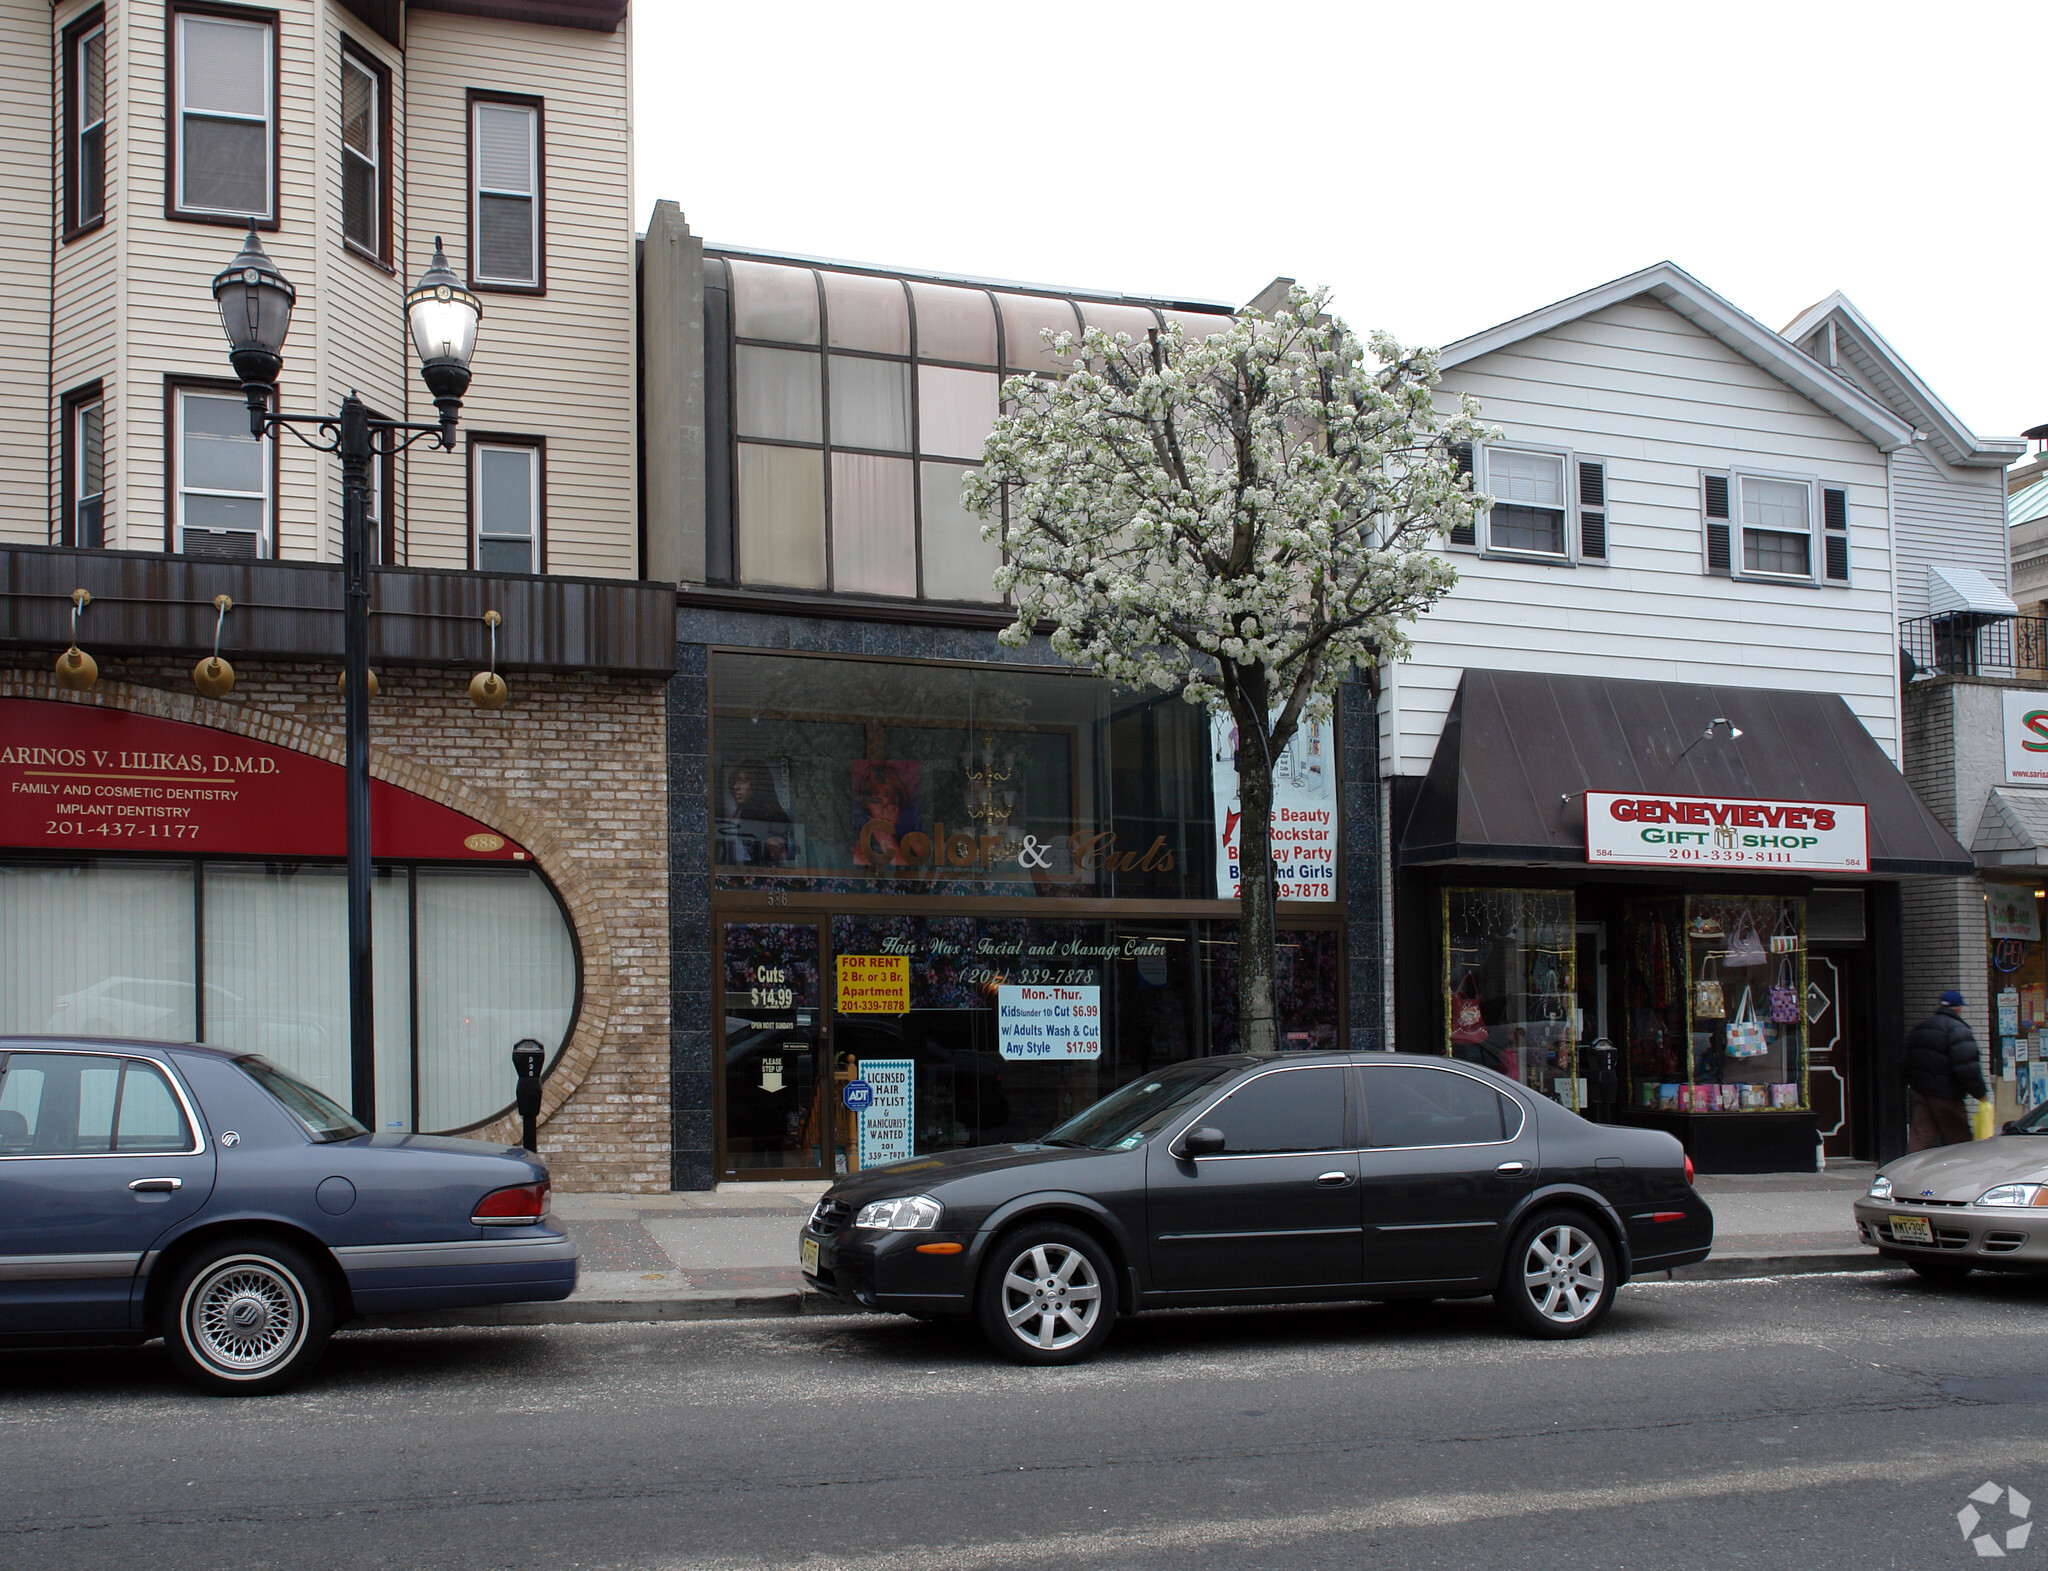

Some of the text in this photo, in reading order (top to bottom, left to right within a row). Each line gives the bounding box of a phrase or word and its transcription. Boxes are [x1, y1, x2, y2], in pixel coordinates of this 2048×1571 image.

[92, 751, 114, 768] V.
[120, 752, 208, 773] LILIKAS,
[213, 755, 280, 774] D.M.D.
[12, 782, 239, 801] FAMILY AND COSMETIC DENTISTRY
[56, 803, 191, 818] IMPLANT DENTISTRY
[1281, 808, 1330, 825] Beauty
[1610, 798, 1836, 831] GENEVIEVE'S
[46, 820, 200, 839] 201-437-1177
[469, 836, 497, 849] 588
[860, 818, 1175, 874] Color & Cuts
[1294, 845, 1332, 863] Party
[1596, 848, 1861, 867] 584 201-339-8111 584
[1277, 864, 1333, 879] nd Girls
[767, 891, 788, 906] 586
[880, 936, 1167, 960] Hair Wax Facial and Massage Center
[1996, 938, 2027, 965] OPEN
[842, 957, 901, 968] FOR RENT
[757, 965, 785, 983] Cuts
[842, 971, 903, 982] 2 Br. or 3 Br.
[959, 968, 1094, 985] (201) 339-7878
[751, 987, 793, 1006] $14.99
[842, 986, 903, 998] Apartment
[1021, 988, 1082, 1000] Mon.-Thur.
[841, 1000, 905, 1011] 201-339-7878
[1054, 1005, 1070, 1017] Cut
[1072, 1004, 1098, 1018] $6.99
[751, 1021, 763, 1030] OPEN
[1001, 1024, 1099, 1037] w/ Adults Wash & Cut
[1006, 1041, 1098, 1056] Any Style $17.99
[762, 1065, 783, 1073] STEP UP
[867, 1072, 906, 1084] LICENSED
[848, 1089, 869, 1102] ADT
[876, 1084, 899, 1095] HAIR
[883, 1109, 889, 1117] &
[867, 1118, 906, 1129] MANICURIST
[870, 1130, 903, 1140] WANTED
